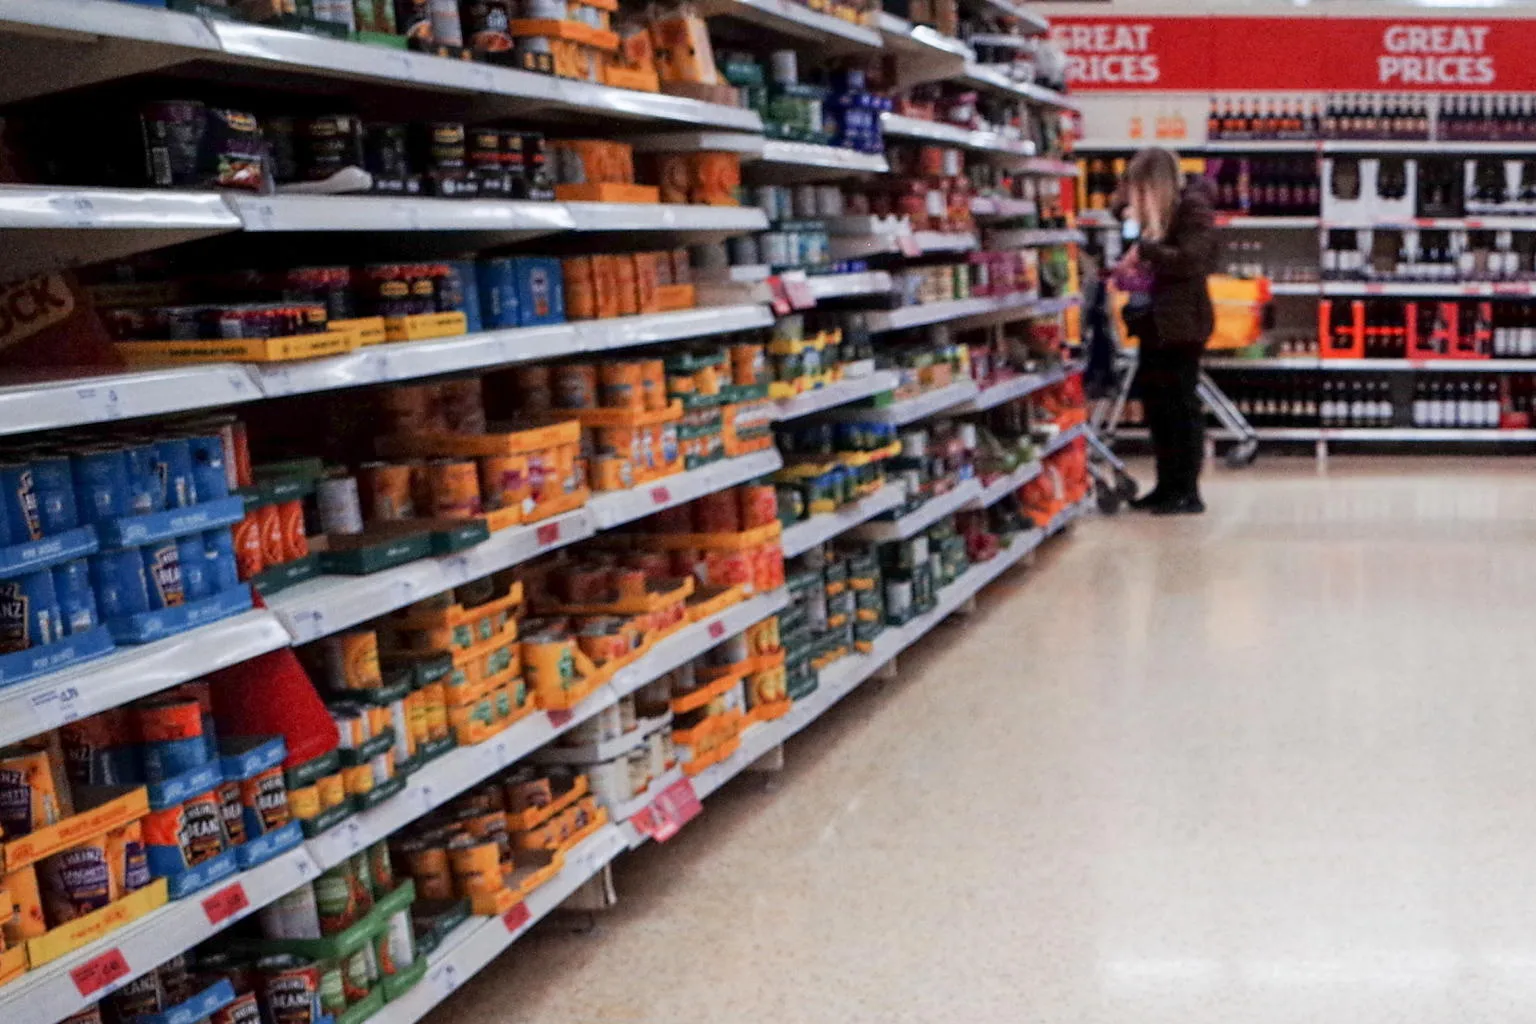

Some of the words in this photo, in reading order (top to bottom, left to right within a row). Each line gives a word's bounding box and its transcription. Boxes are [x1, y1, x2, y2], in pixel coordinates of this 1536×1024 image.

[1051, 24, 1153, 51] GREAT
[1383, 25, 1490, 54] GREAT
[1065, 54, 1160, 83] RICES
[1378, 56, 1496, 84] PRICES
